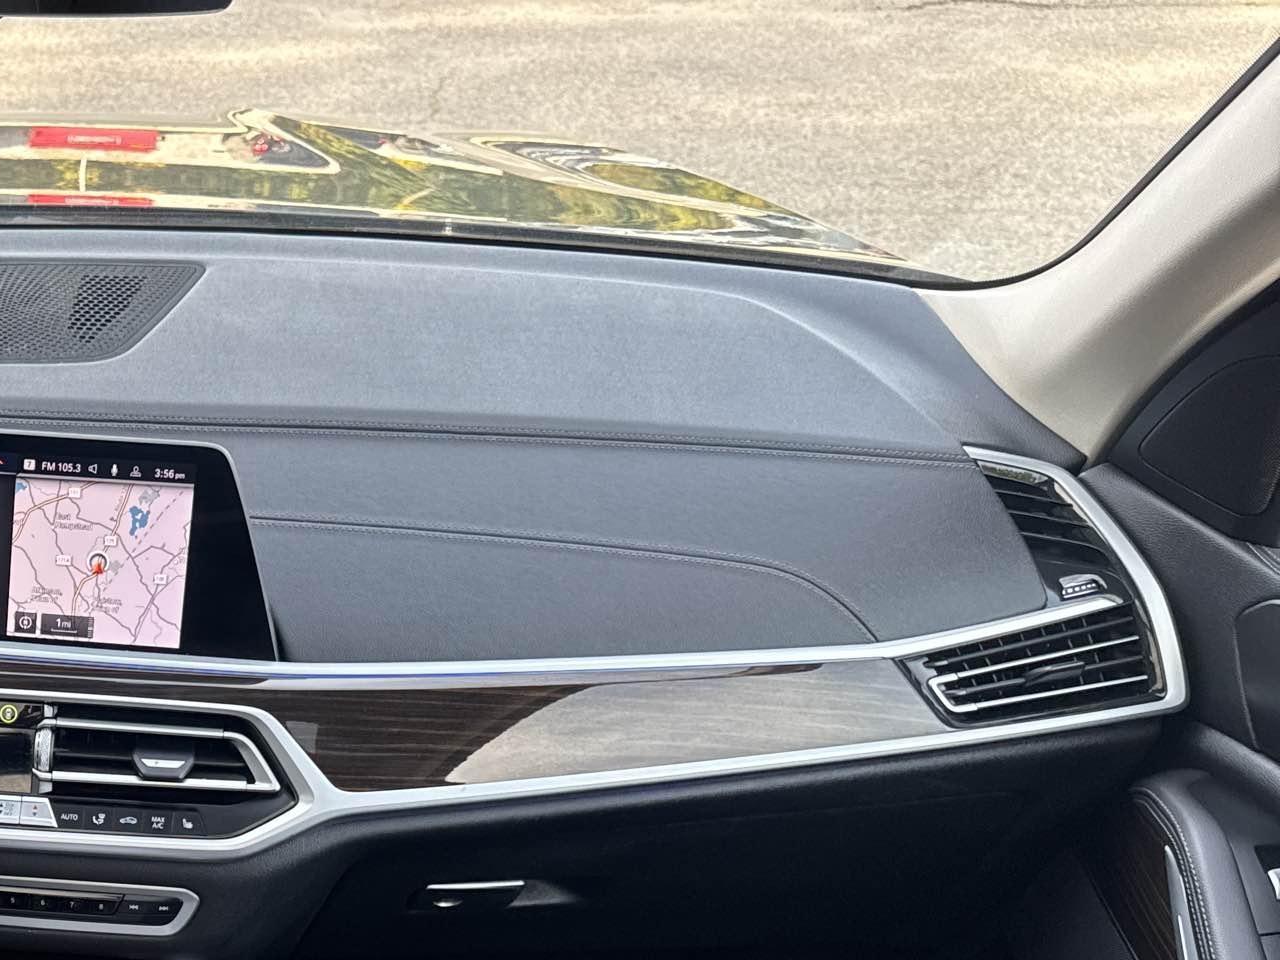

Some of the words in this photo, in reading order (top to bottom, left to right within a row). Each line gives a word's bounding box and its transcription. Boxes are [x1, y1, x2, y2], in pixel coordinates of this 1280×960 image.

[41, 461, 56, 471] FM
[57, 463, 81, 473] 105.3
[154, 468, 175, 479] 3:56
[175, 472, 186, 480] pm
[61, 813, 78, 822] AUTO
[152, 822, 164, 830] A/C
